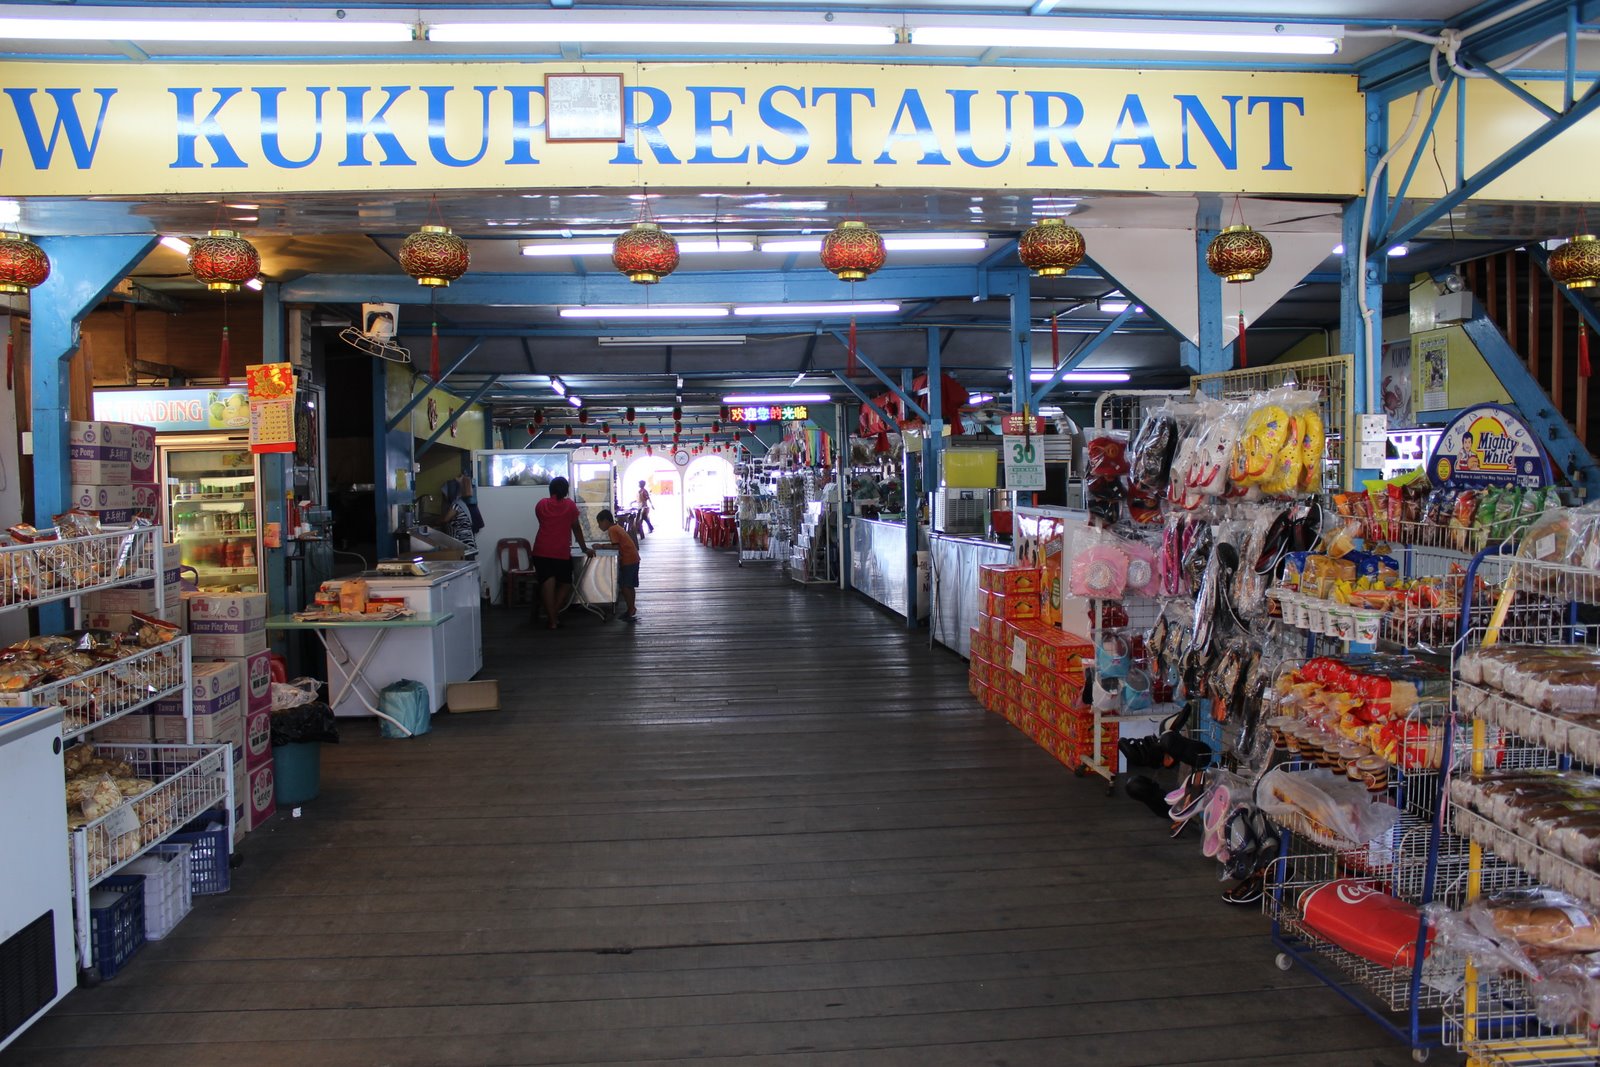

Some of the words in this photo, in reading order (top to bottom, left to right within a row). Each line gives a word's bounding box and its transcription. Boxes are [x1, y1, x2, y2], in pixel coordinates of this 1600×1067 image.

[0, 88, 118, 171] W
[608, 84, 1305, 171] RESTAURANT
[116, 399, 203, 423] TRADING
[731, 405, 807, 421] 欢迎您的光临
[80, 447, 95, 458] Pong
[1477, 432, 1519, 453] Mighty
[1013, 443, 1036, 464] 30
[1483, 450, 1514, 465] White
[192, 622, 210, 631] Tawar
[211, 621, 224, 632] Ping
[224, 622, 239, 633] Pong
[1337, 883, 1373, 905] Coc
